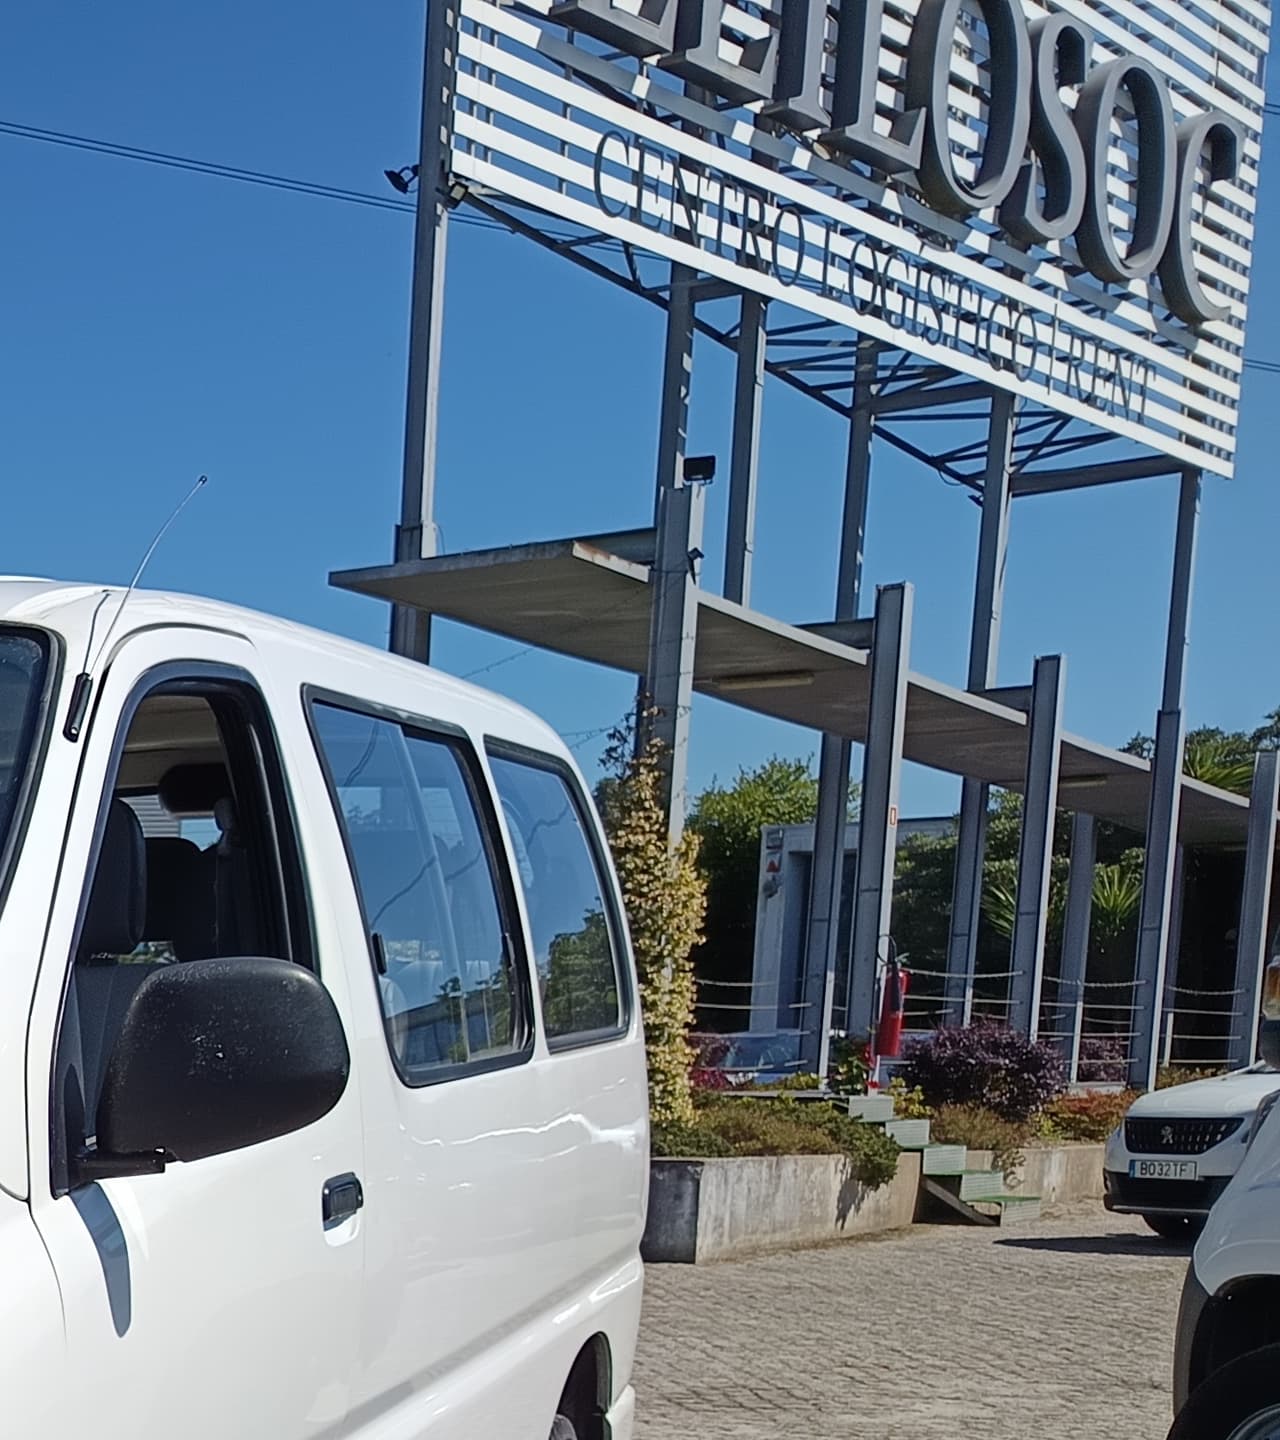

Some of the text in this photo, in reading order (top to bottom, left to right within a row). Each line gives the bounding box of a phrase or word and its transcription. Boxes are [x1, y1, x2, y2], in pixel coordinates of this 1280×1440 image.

[548, 0, 1240, 324] LOSOC
[594, 130, 806, 287] CENTRO
[1060, 323, 1157, 425] RENT
